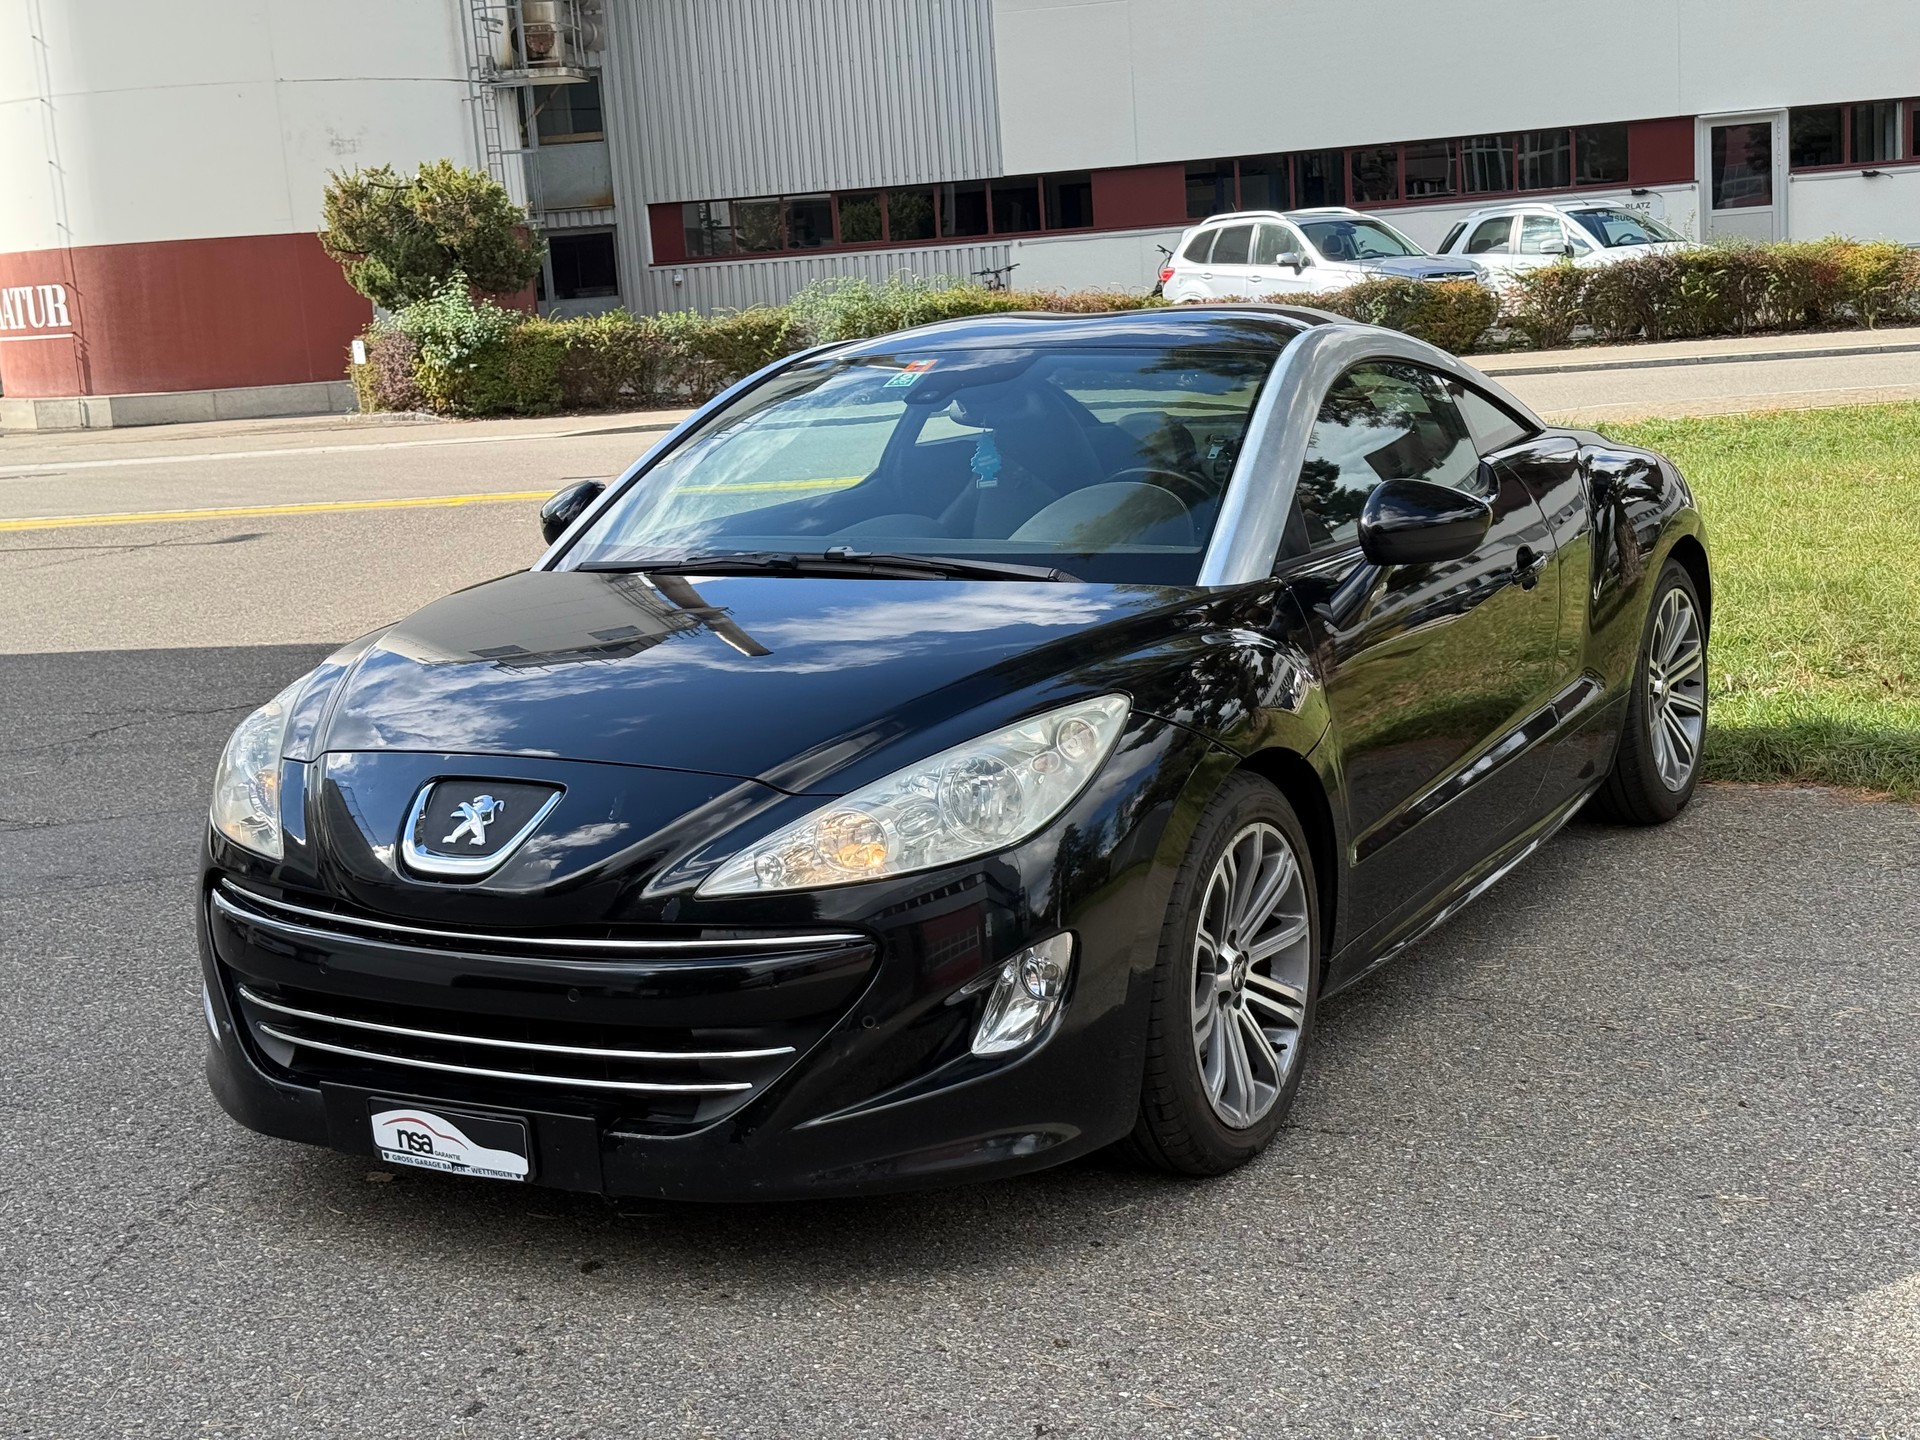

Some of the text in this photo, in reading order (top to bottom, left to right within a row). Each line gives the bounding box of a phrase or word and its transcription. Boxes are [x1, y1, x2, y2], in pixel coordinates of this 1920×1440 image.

[1623, 202, 1650, 210] PLATZ
[0, 284, 72, 330] ATUR
[397, 1129, 434, 1155] nsa
[392, 1155, 413, 1163] GROSS
[415, 1158, 441, 1169] GARAGE
[471, 1167, 513, 1178] WETTINGEN
[435, 1151, 461, 1161] GARANTIE
